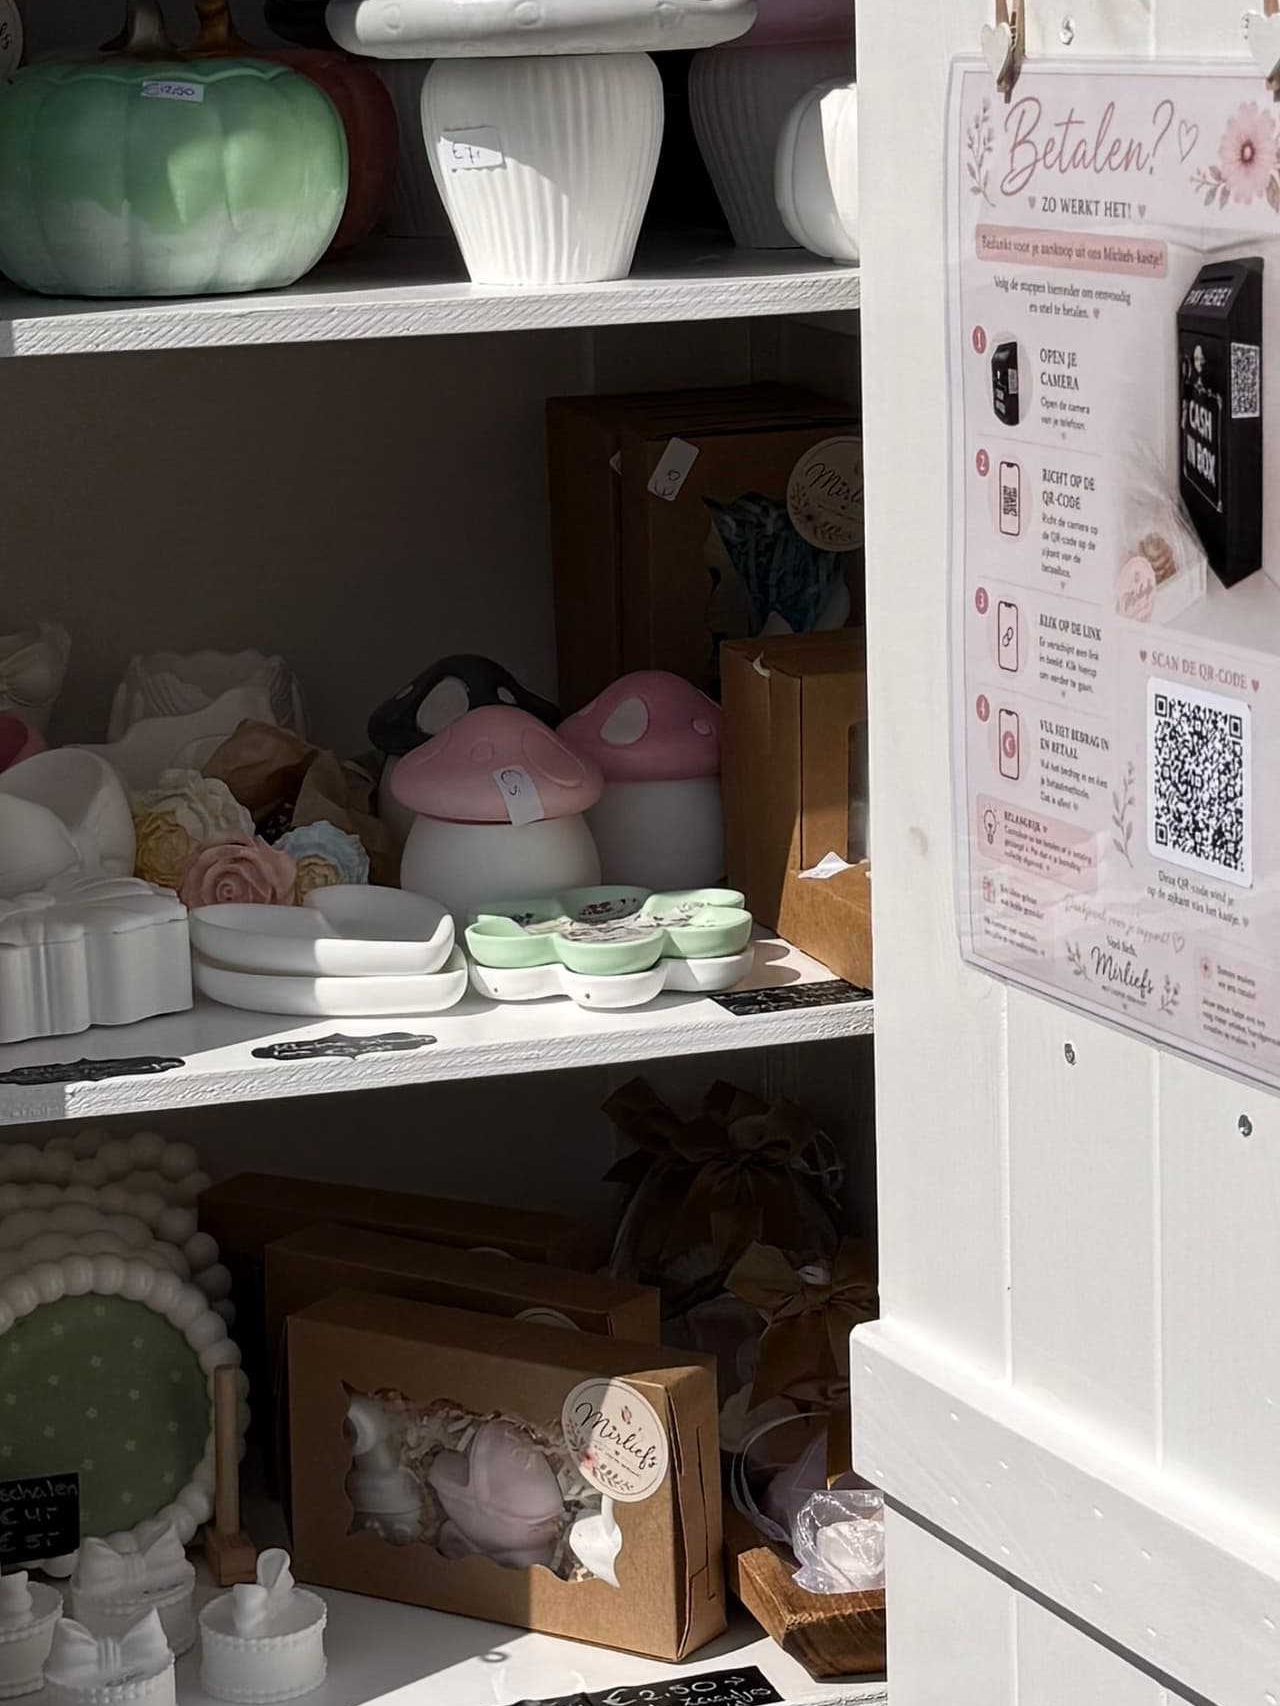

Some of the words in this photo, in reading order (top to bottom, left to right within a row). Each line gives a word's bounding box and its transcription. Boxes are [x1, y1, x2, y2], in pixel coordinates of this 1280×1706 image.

[1000, 97, 1175, 196] Betalen?
[1041, 197, 1057, 213] ZO
[1060, 198, 1100, 216] WERKT
[1103, 201, 1132, 219] HET!
[1040, 348, 1065, 367] OPEN
[1067, 351, 1078, 370] JE
[1039, 372, 1080, 391] CAMERA
[1188, 399, 1213, 444] CASH
[1069, 475, 1082, 489] OP
[1196, 443, 1217, 487] BOX
[1151, 651, 1179, 671] SCAN
[1181, 658, 1198, 676] DE
[1199, 663, 1249, 690] QR-CODE
[1091, 946, 1154, 1000] Mirliefs
[575, 1401, 657, 1471] Mirliefs
[0, 1479, 78, 1502] schalen
